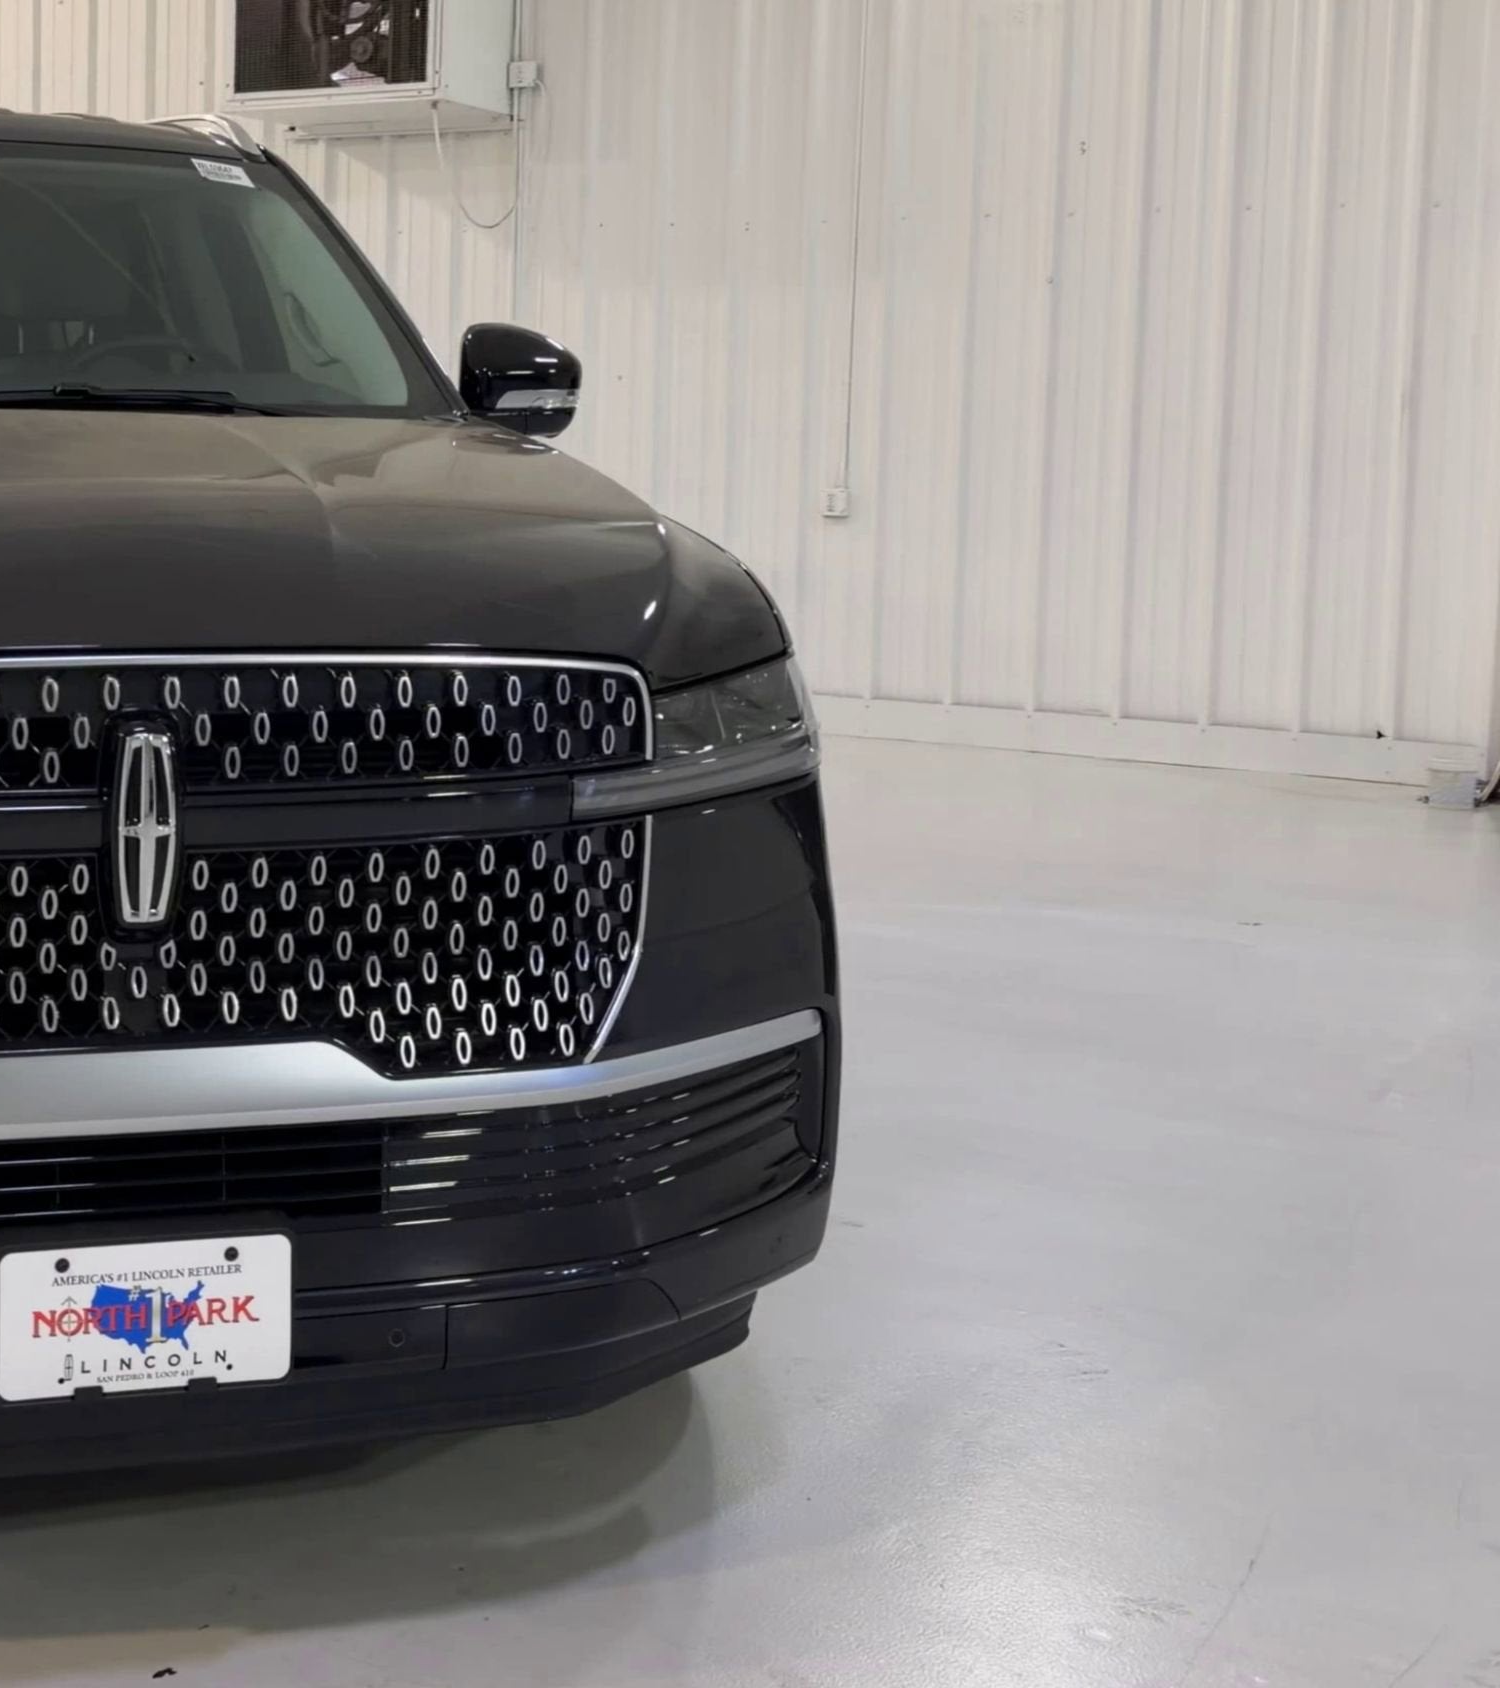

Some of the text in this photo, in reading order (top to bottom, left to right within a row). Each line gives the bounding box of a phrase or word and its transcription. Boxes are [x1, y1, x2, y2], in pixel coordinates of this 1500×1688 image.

[51, 1263, 242, 1287] AMERICA'S #1 LINCOLN RETAILER
[32, 1295, 260, 1338] NORTH PARK
[80, 1350, 227, 1374] LINCOLN
[97, 1376, 113, 1384] SAN
[115, 1373, 145, 1382] PEDRO
[155, 1370, 179, 1379] LOOP
